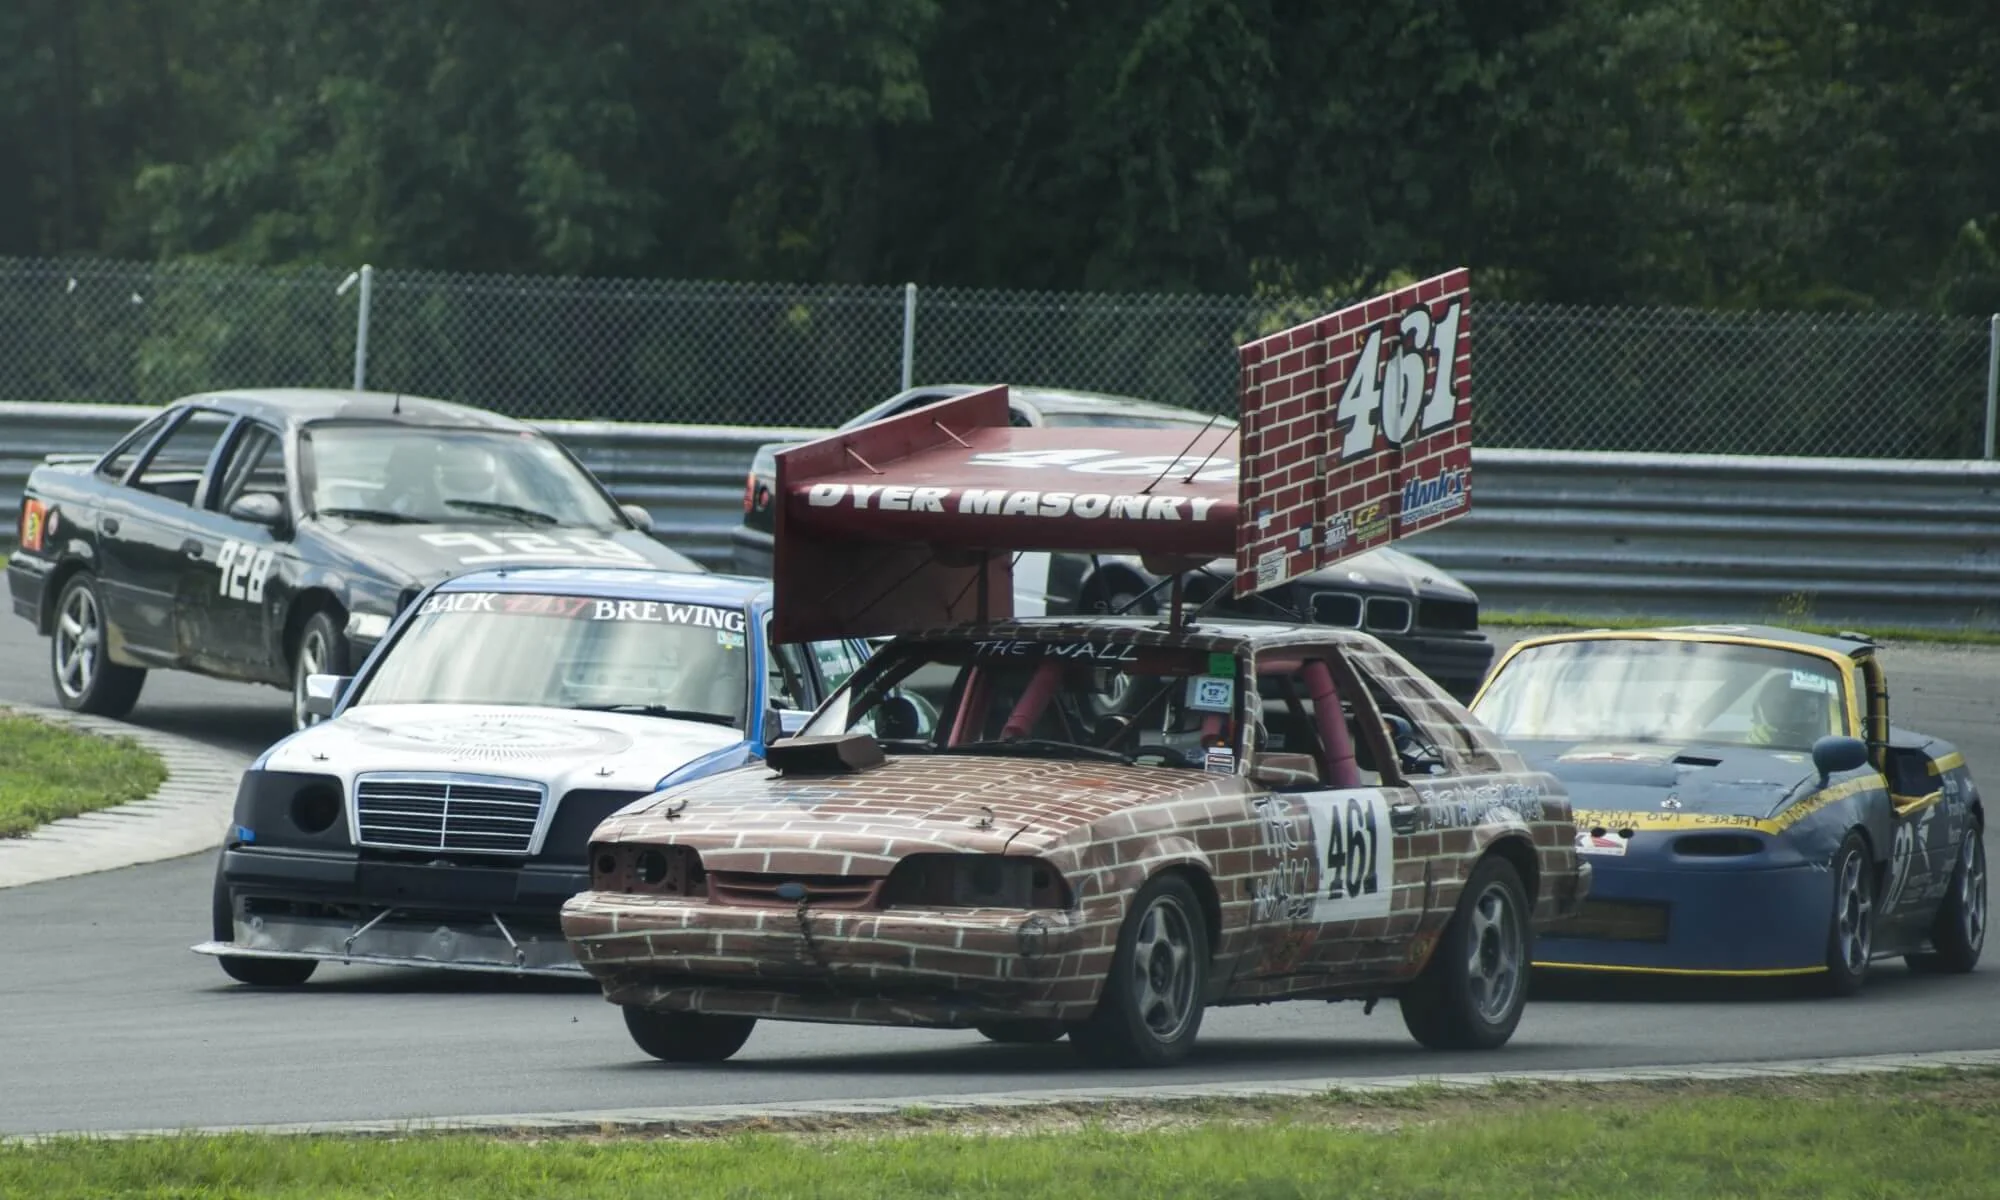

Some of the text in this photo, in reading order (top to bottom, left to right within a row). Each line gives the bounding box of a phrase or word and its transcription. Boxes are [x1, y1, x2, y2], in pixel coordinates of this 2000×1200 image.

[1336, 300, 1461, 460] 461
[964, 449, 1239, 480] 46
[808, 483, 952, 513] DYER
[958, 488, 1221, 522] MASONRY
[418, 532, 648, 563] 928
[215, 540, 274, 603] 928
[417, 592, 499, 615] BACK
[593, 599, 747, 632] BREWING
[974, 640, 1138, 661] THE WALL
[1327, 797, 1379, 900] 461
